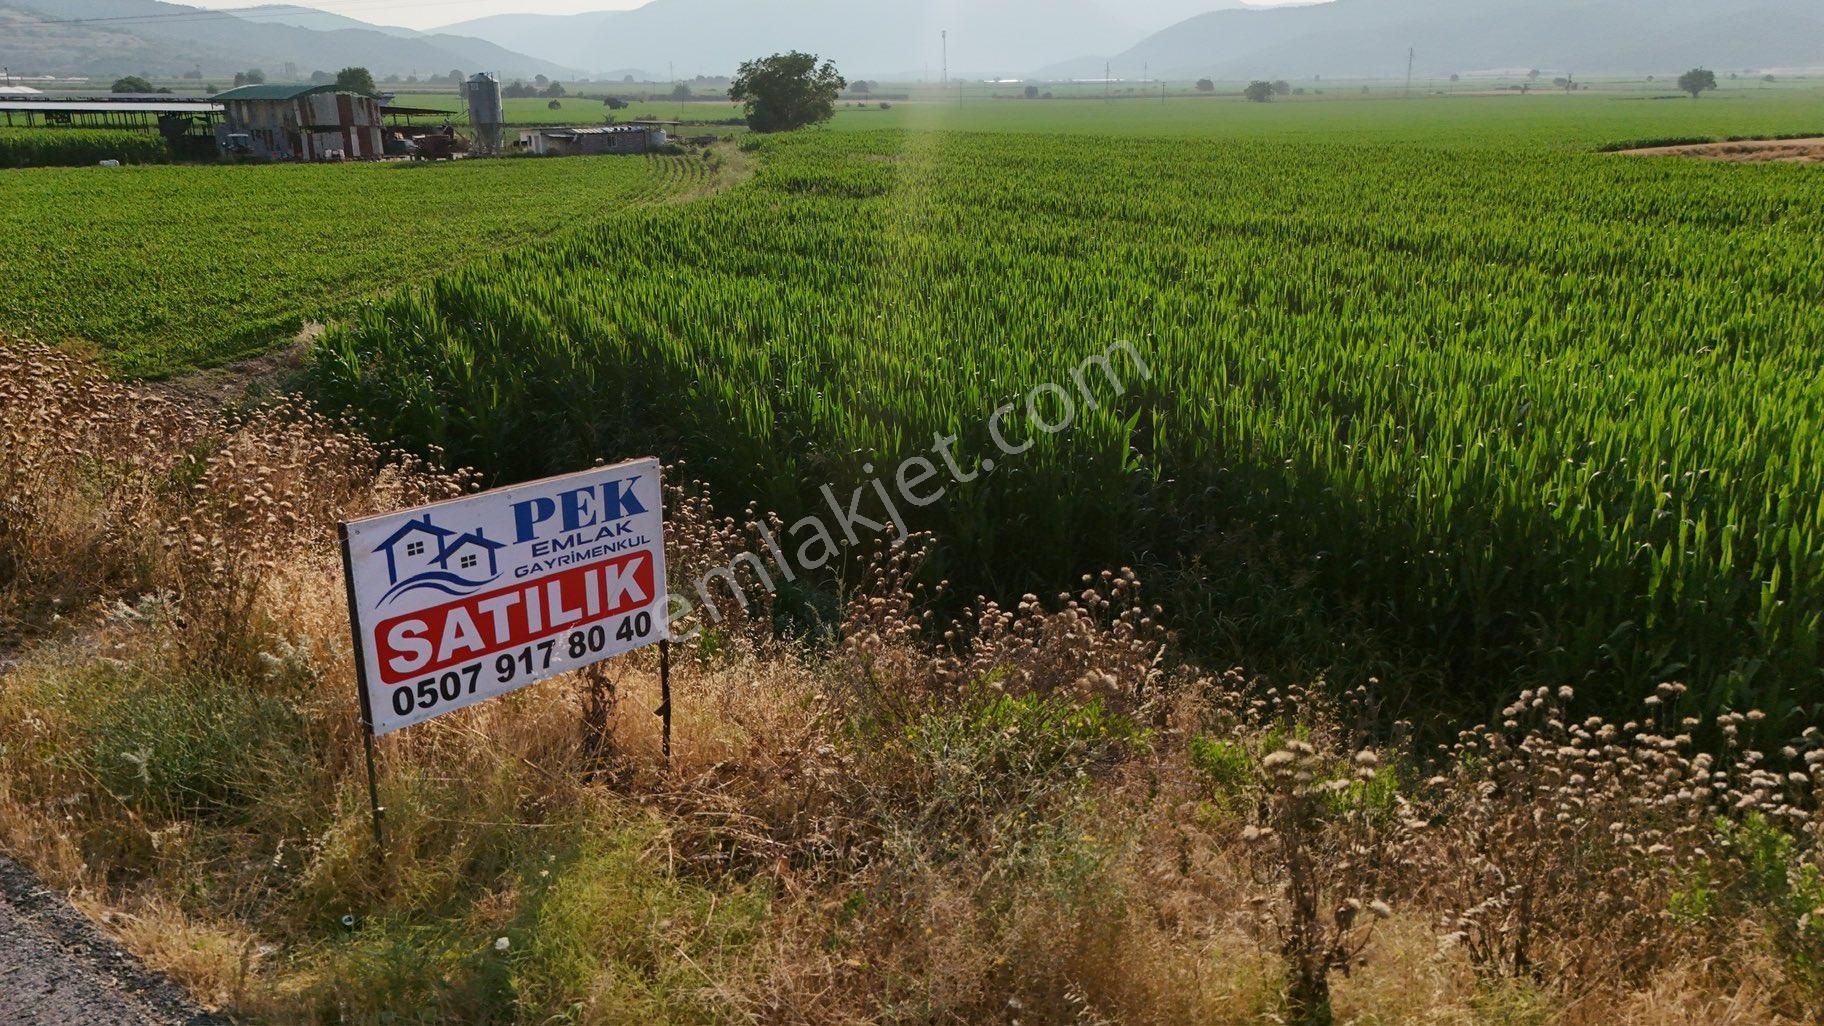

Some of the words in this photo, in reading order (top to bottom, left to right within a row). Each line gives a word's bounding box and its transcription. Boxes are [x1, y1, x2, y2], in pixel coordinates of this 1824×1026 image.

[509, 475, 649, 545] PEK
[531, 520, 634, 558] EMLAK
[514, 534, 651, 579] GAYRİMENKUL
[387, 556, 648, 673] SATILIK
[392, 663, 483, 716] 0507
[495, 639, 555, 683] 917
[568, 626, 606, 659] 80
[615, 611, 651, 642] 40
